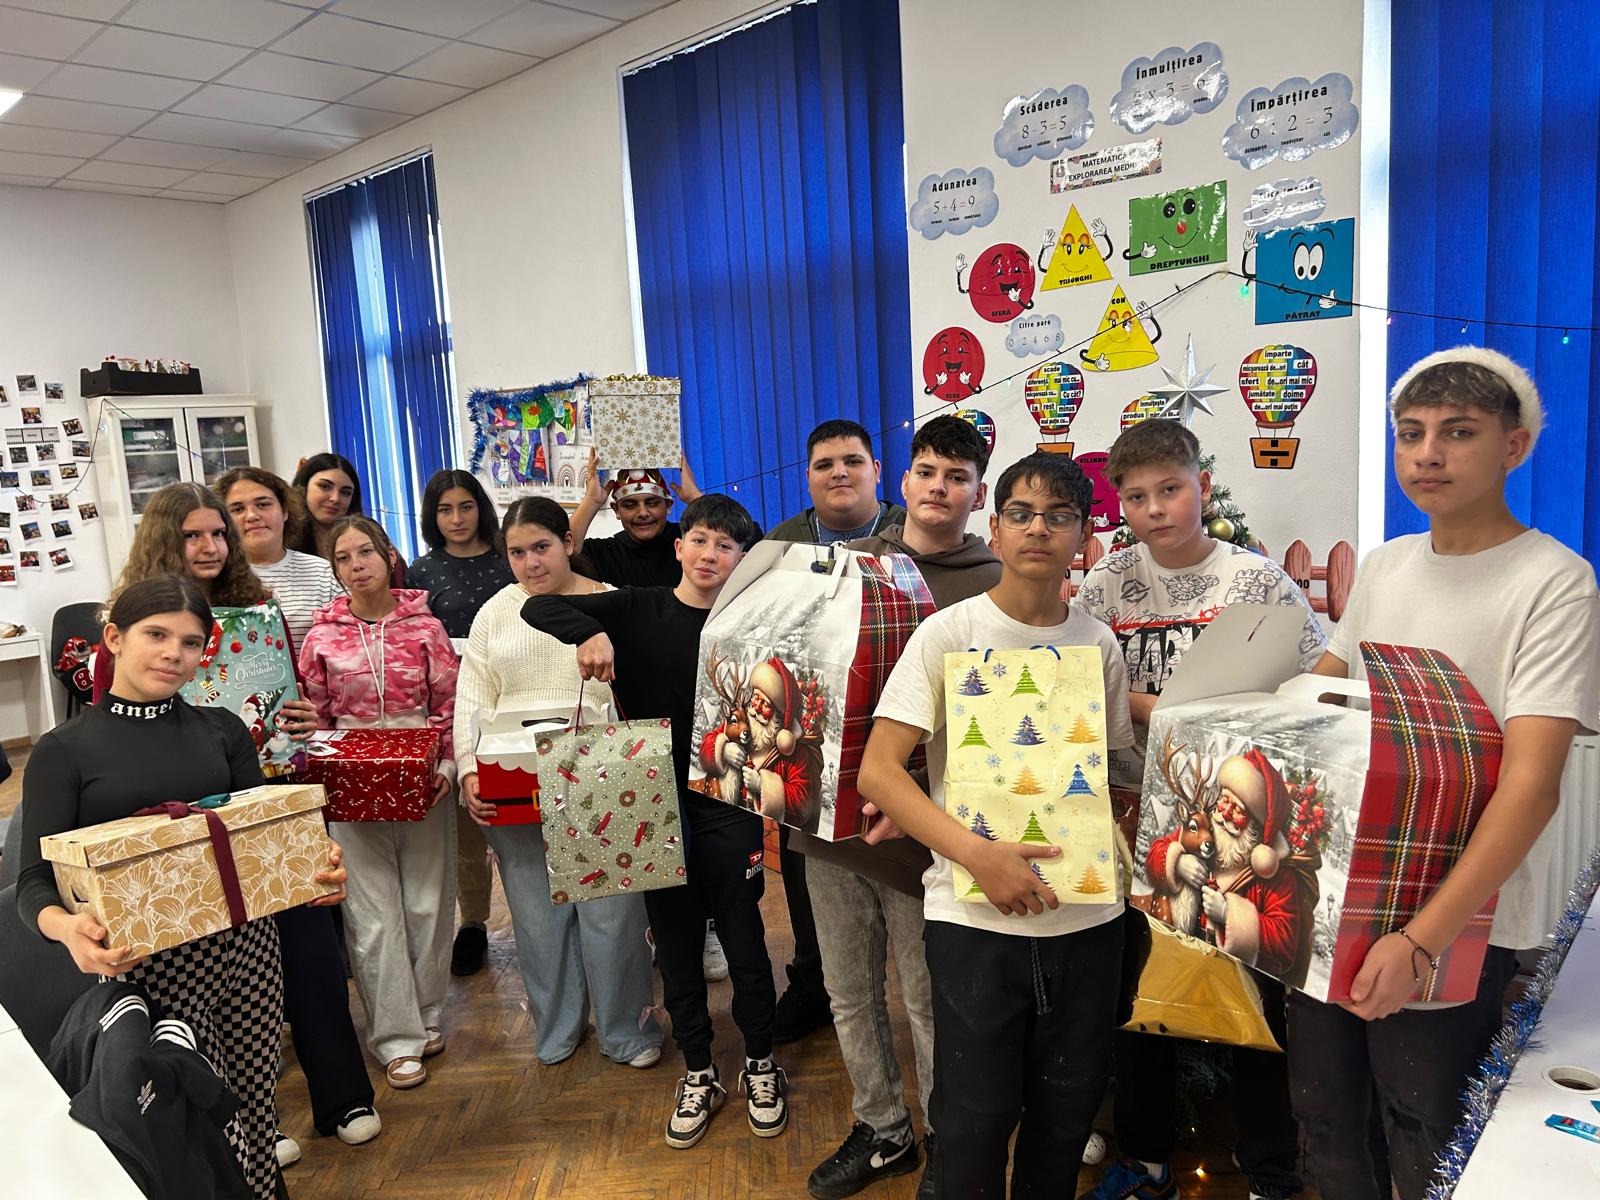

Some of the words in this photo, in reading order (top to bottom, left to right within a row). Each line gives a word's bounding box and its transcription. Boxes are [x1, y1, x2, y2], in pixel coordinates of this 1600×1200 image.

[1020, 96, 1068, 116] Scăderea
[1250, 86, 1328, 112] Împărțirea
[1022, 124, 1029, 139] 8
[1040, 120, 1047, 135] 3
[1059, 115, 1067, 130] 5
[1250, 123, 1260, 140] 6
[1287, 114, 1298, 132] 2
[1322, 106, 1333, 124] 3
[1068, 168, 1113, 181] EXPLORAREA
[931, 177, 977, 192] Adunarea
[1150, 254, 1210, 270] DREPTUNGHI
[1018, 321, 1034, 329] Cifre
[1036, 319, 1051, 327] pare
[1241, 377, 1259, 385] sfert
[1301, 376, 1313, 384] mic
[1122, 412, 1145, 420] produs
[1292, 578, 1310, 589] 00
